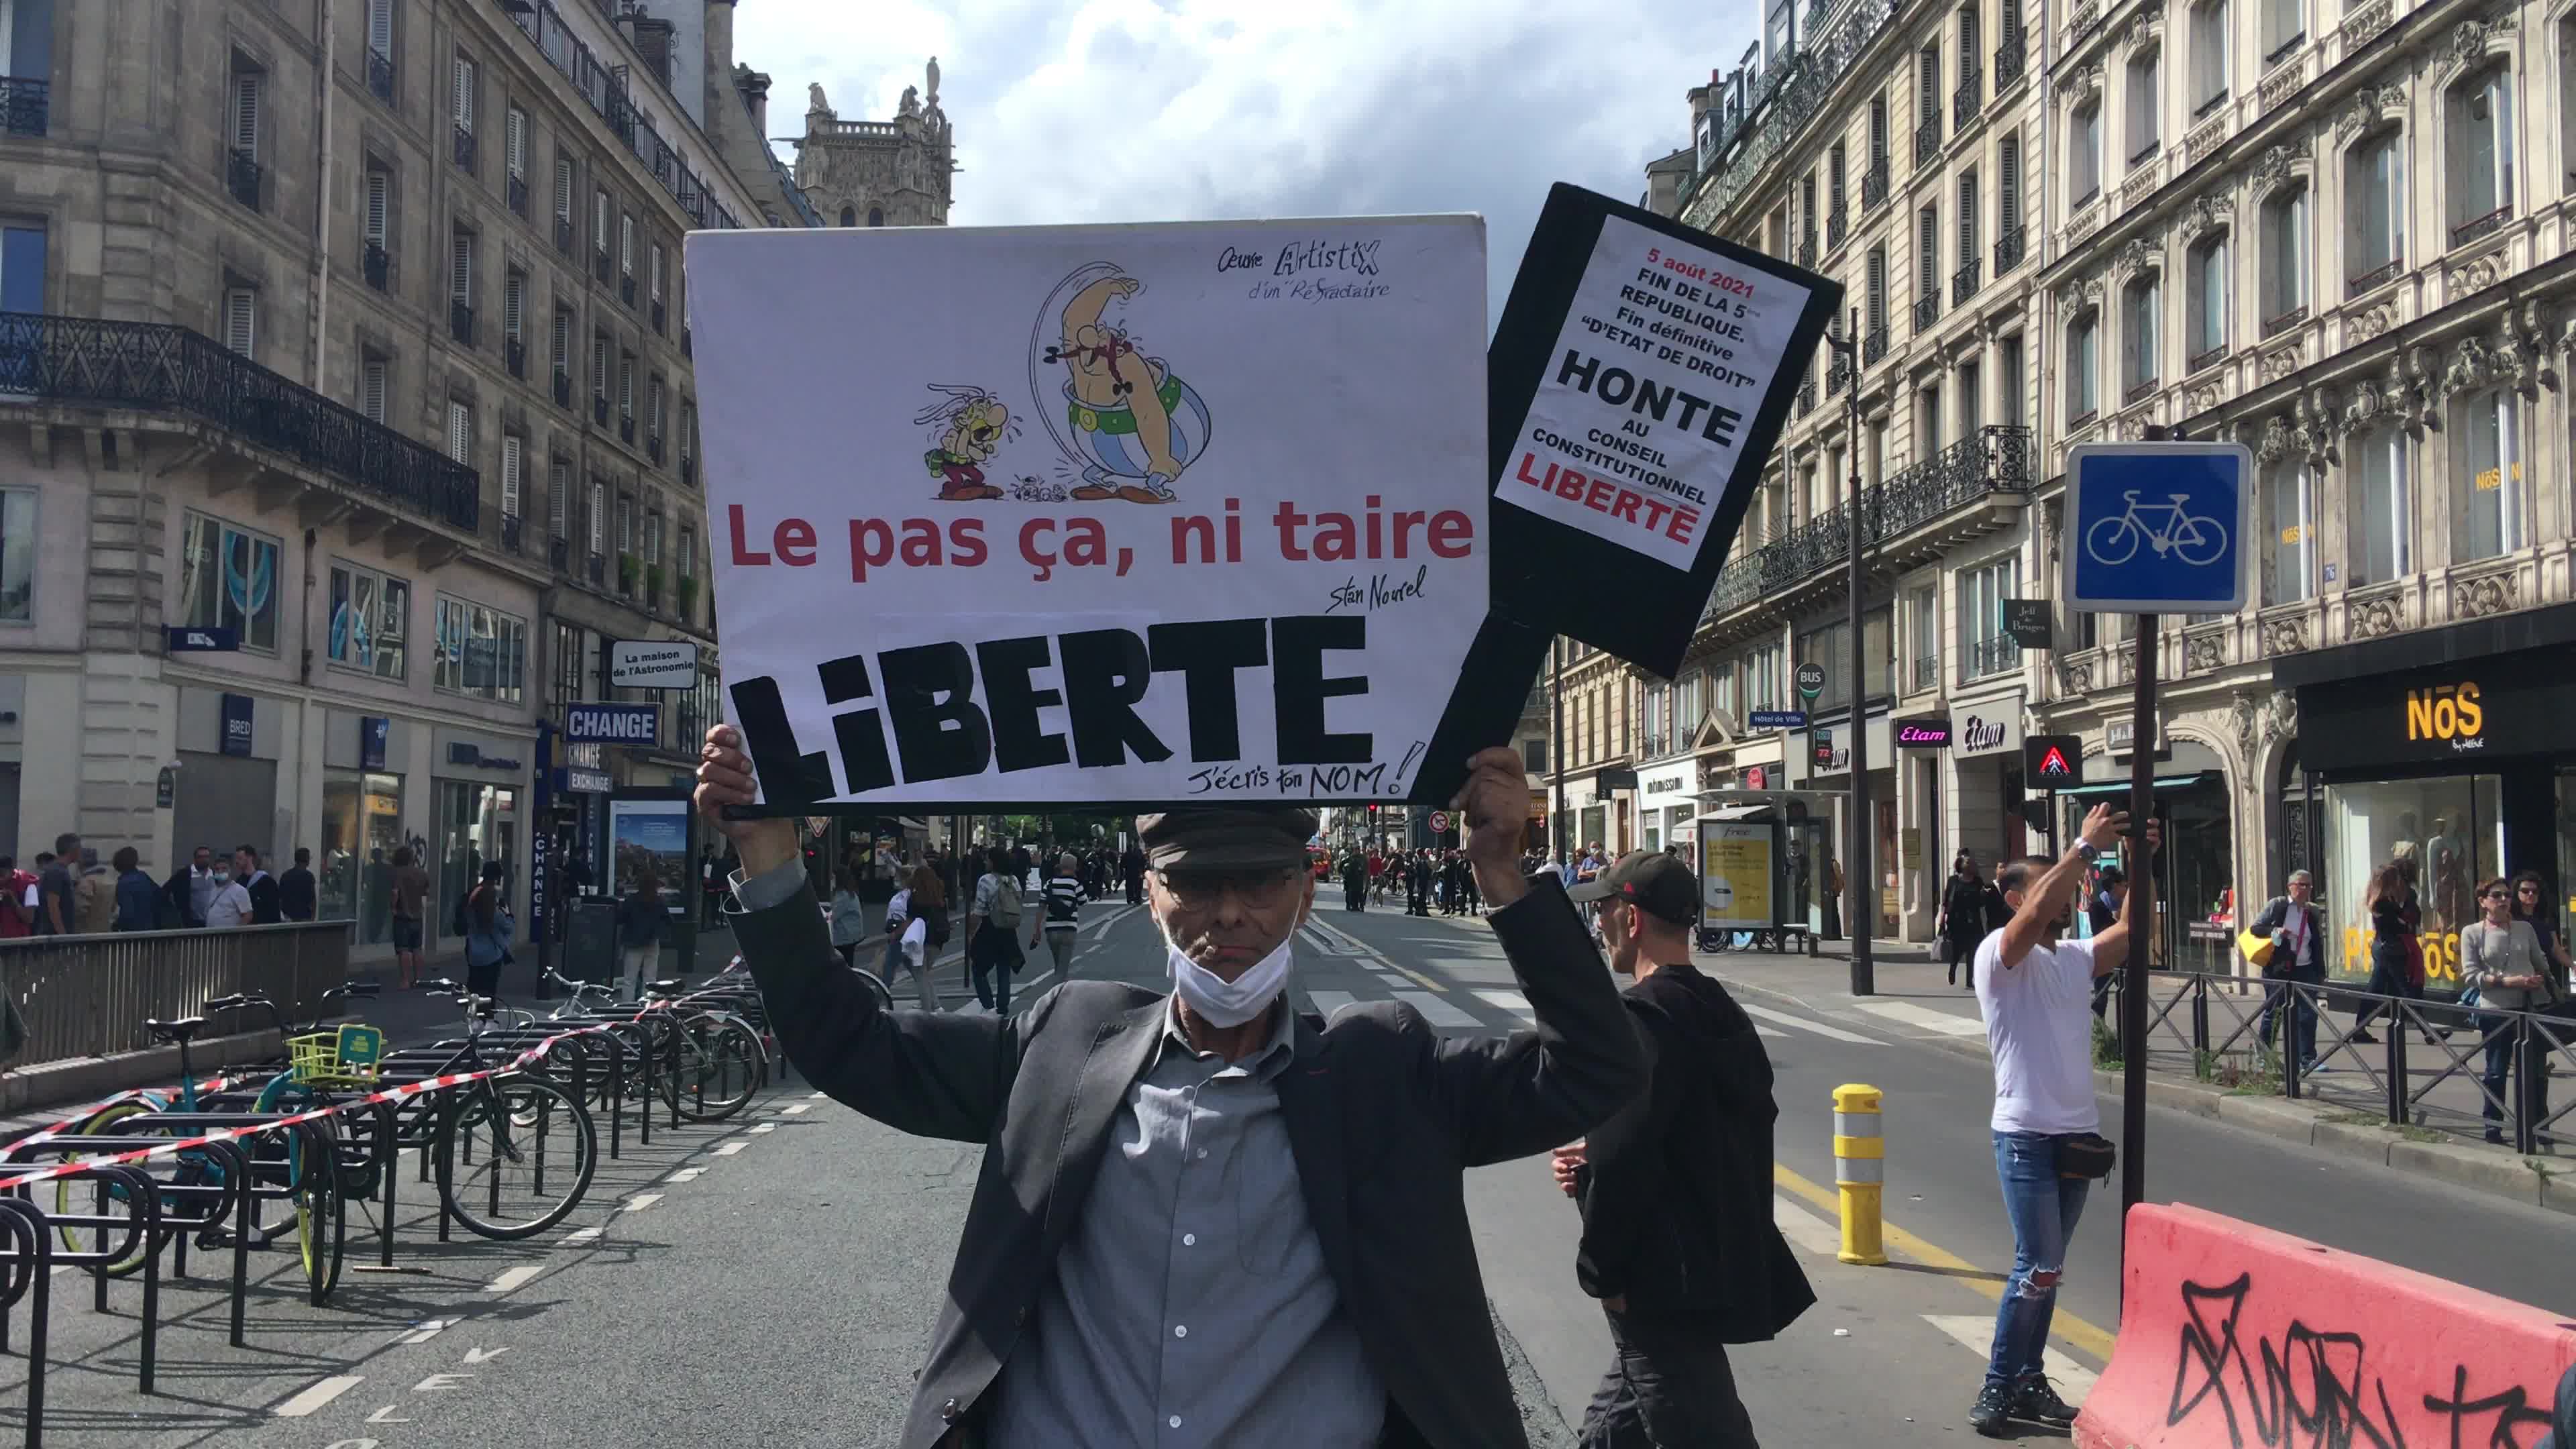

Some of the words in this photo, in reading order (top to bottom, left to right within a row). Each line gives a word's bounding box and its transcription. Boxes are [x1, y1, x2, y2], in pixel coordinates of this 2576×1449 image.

[1648, 248, 1661, 264] 5
[1663, 256, 1707, 281] août
[1707, 271, 1756, 299] 2021
[1637, 268, 1672, 290] FIN
[1674, 281, 1701, 303] DE
[1704, 294, 1728, 314] LA
[1619, 284, 1745, 343] REPUBLIQUE.
[1616, 306, 1645, 328] Fin
[1649, 319, 1734, 362] définitive
[1657, 345, 1684, 366] DE
[1556, 349, 1743, 447] HONTE
[1621, 419, 1651, 437] AU
[1587, 428, 1668, 468] CONSEIL
[1532, 428, 1707, 505] CONSTITUTIONNEL
[729, 504, 817, 567] Le
[849, 517, 988, 583] pas
[1018, 517, 1133, 582] ça,
[1171, 498, 1242, 564] ni
[1273, 495, 1474, 562] taire
[613, 668, 626, 678] de
[629, 661, 694, 676] l'Astronomie
[625, 654, 638, 663] La
[641, 651, 680, 662] maison
[1801, 672, 1821, 682] BUS
[230, 719, 251, 735] BRED
[570, 711, 654, 739] CHANGE
[1900, 726, 1946, 741] Etam
[1964, 715, 2005, 751] Etam
[568, 743, 601, 770] CHANGE
[1817, 749, 1830, 757] 72
[572, 773, 609, 792] EXCHANGE
[1187, 765, 1270, 794] J'écris
[1276, 769, 1302, 794] ton
[534, 839, 545, 918] CHANGE
